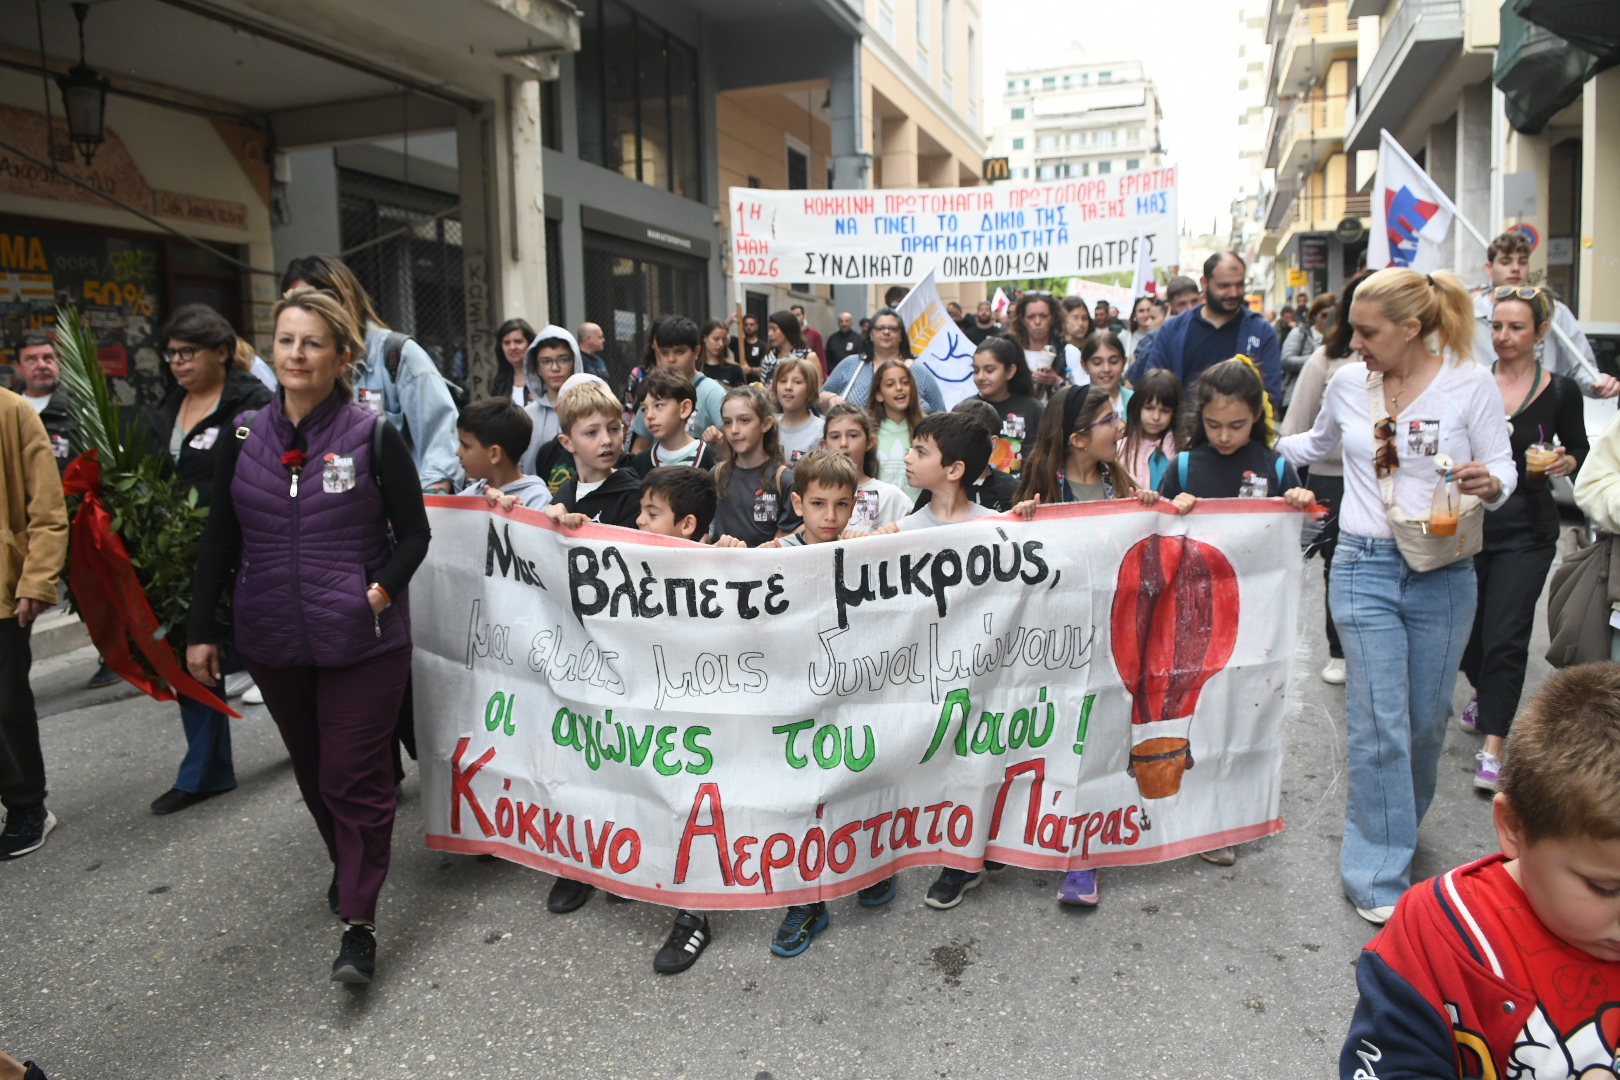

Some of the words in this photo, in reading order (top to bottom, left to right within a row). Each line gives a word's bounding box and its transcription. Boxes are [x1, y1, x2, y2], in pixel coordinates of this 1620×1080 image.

[804, 195, 875, 216] ΚΟΚΚΙΝΗ
[885, 192, 994, 214] ΠΡΩΤΟΜΑΓΙΑ
[1009, 179, 1107, 208] ΠΡΩΤΟΠΟΡΑ
[1119, 167, 1175, 197] ΕΡΓΑΤΙΑ
[835, 216, 858, 235] ΝΑ
[874, 215, 915, 235] ΓΙΝΕΙ
[937, 214, 958, 232] ΤΟ
[981, 210, 1024, 232] ΔΙΚΙΟ
[1035, 205, 1069, 227] ΤΗΣ
[1080, 198, 1126, 222] ΤΑΞΗΣ
[1136, 191, 1168, 215] ΜΑΣ
[901, 227, 1069, 253] ΠΡΑΓΜΑΤΙΚΟΤΗΤΑ
[738, 257, 780, 278] 2026
[804, 252, 913, 279] ΣΥΝΔΙΚΑΤΟ
[943, 252, 1049, 278] ΟΙΚΟΔΟΜΩΝ
[484, 517, 548, 591] Μας
[466, 599, 514, 670] μα
[484, 691, 515, 736] οι
[551, 709, 714, 775] αγώνες
[771, 717, 876, 773] του
[450, 736, 641, 874] Κόκκινο
[673, 782, 974, 895] Αερόστατο
[987, 757, 1140, 861] Πάτρας
